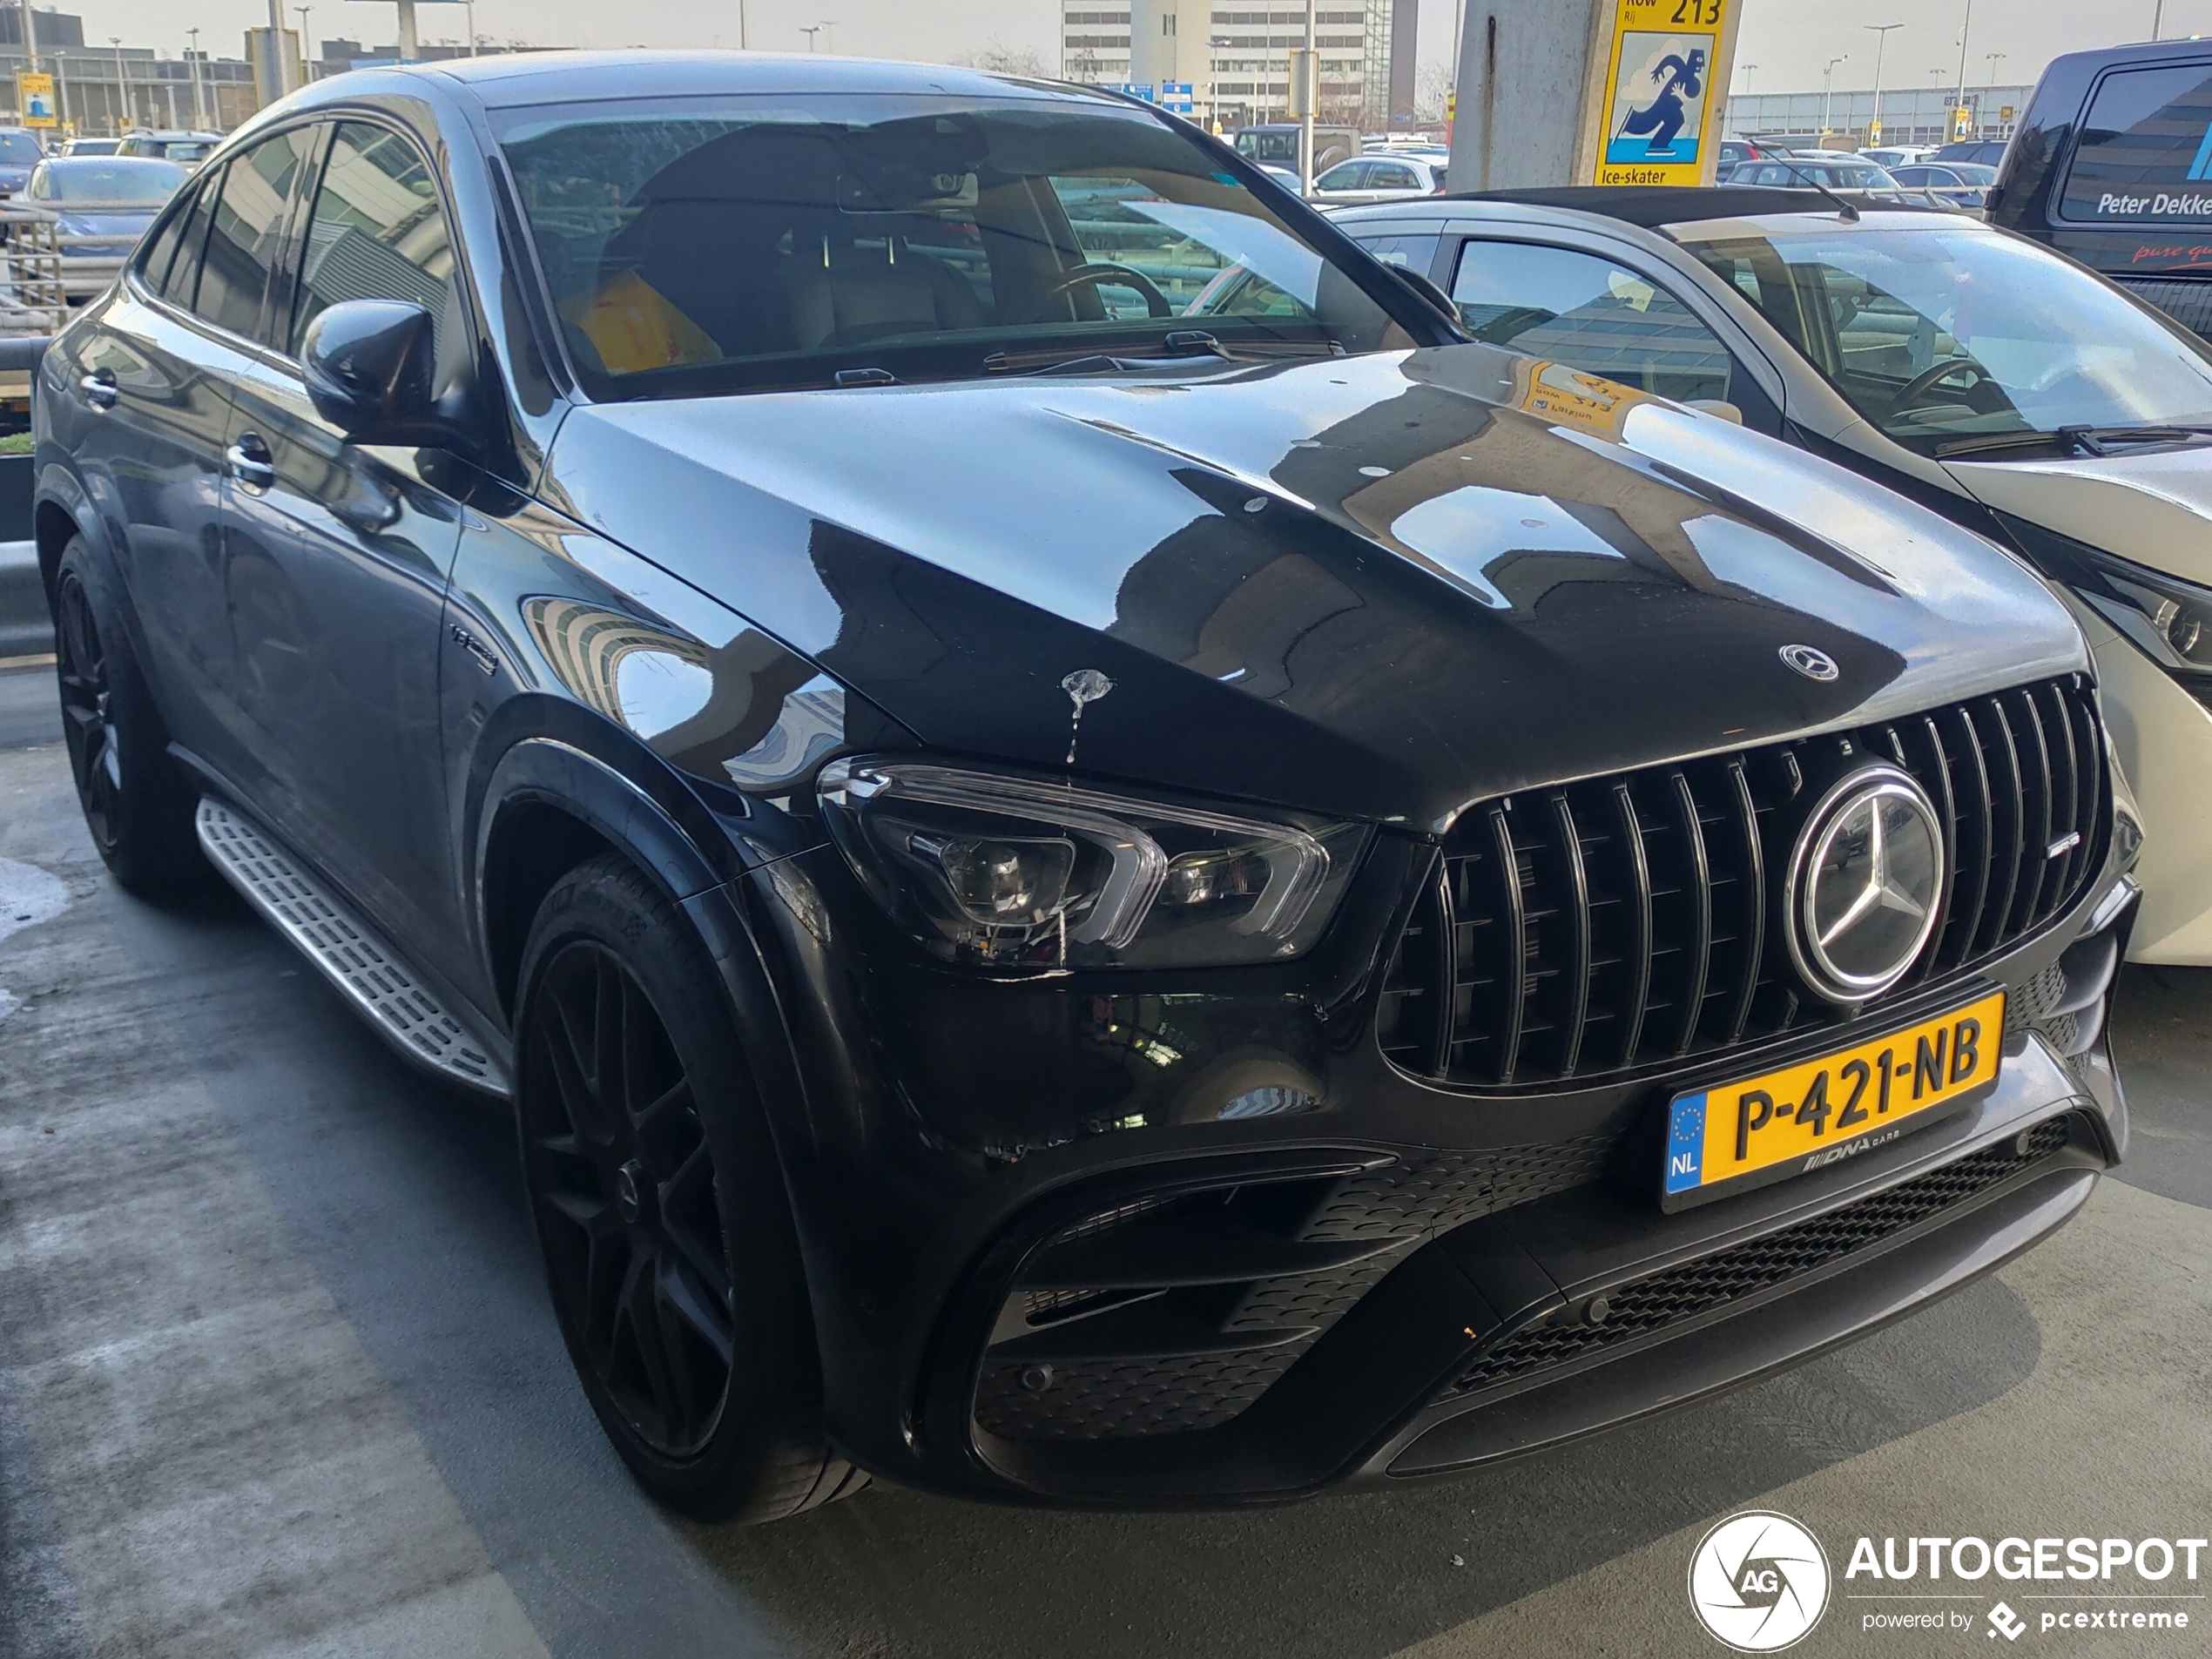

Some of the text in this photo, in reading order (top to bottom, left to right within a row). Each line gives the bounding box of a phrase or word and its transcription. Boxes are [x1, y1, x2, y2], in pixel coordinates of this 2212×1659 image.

[1624, 10, 1635, 25] Rij
[1670, 0, 1722, 25] 213
[1602, 168, 1666, 184] Ice-skater
[2097, 193, 2212, 215] Peter Dekke
[2131, 246, 2184, 264] pure
[1736, 1017, 1981, 1161] P-421-NB
[1671, 1155, 1697, 1177] NL
